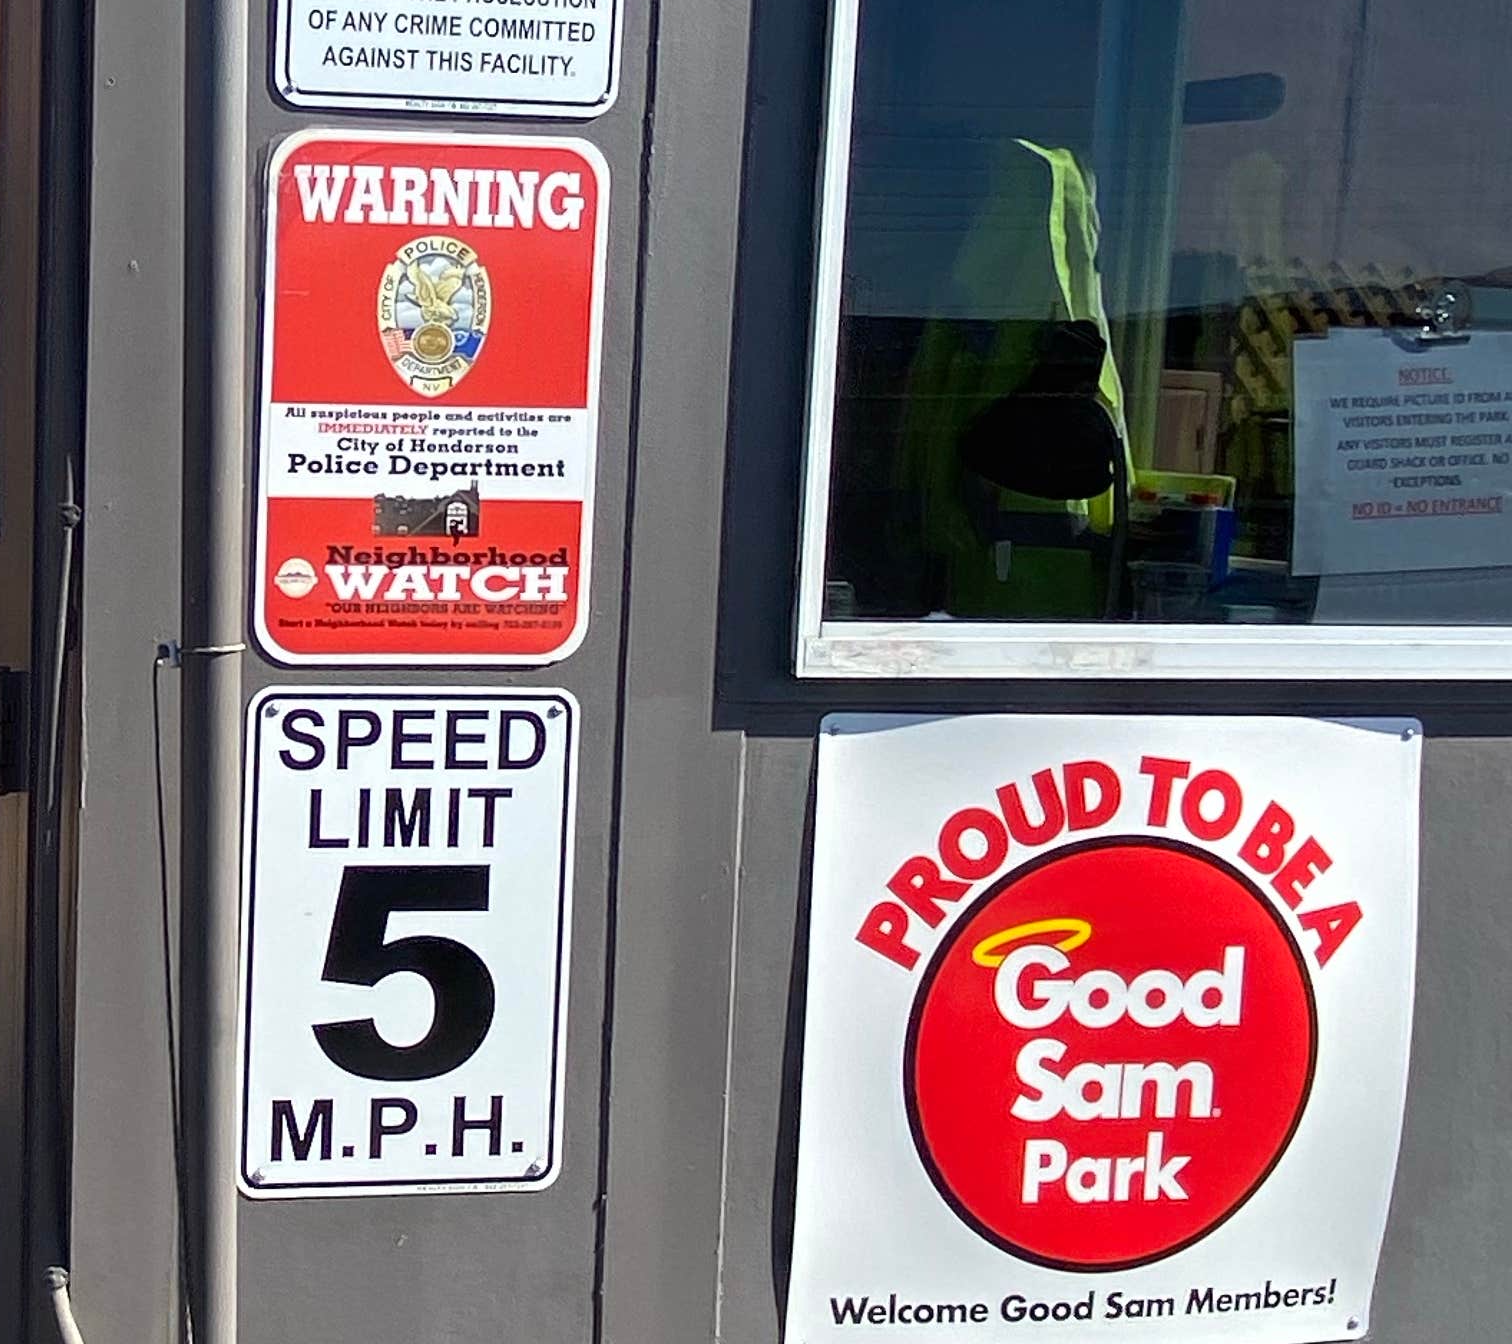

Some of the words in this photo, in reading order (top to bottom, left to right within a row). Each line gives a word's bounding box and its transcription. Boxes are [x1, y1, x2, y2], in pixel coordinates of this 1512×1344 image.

[308, 10, 338, 30] OF
[342, 11, 388, 33] ANY
[394, 13, 462, 36] CRIME
[469, 17, 595, 42] COMMITTED
[322, 46, 419, 70] AGAINST
[426, 50, 473, 72] THIS
[480, 53, 576, 77] FACILITY.
[293, 164, 585, 231] WARNING
[404, 240, 470, 261] POLICE
[382, 294, 392, 320] CITY
[402, 358, 462, 375] DEPARTMENT
[1330, 397, 1348, 408] WE
[1351, 396, 1400, 408] REQUIRE
[1403, 393, 1449, 406] PICTURE
[1453, 393, 1466, 404] ID
[1469, 392, 1501, 403] FROM
[285, 407, 306, 418] All
[311, 409, 387, 421] suspicious
[392, 411, 440, 422] people
[445, 412, 473, 422] and
[477, 412, 543, 422] activities
[1343, 415, 1393, 428] VISITORS
[1396, 413, 1452, 426] ENTERING
[1455, 412, 1476, 424] THE
[318, 423, 427, 435] IMMEDIATELY
[432, 427, 494, 438] reported
[499, 427, 512, 436] to
[517, 427, 538, 437] the
[1337, 440, 1360, 451] ANY
[1363, 438, 1412, 449] VISITORS
[1415, 436, 1447, 448] MUST
[1450, 434, 1502, 446] REGISTER
[337, 437, 379, 453] City
[385, 439, 404, 452] of
[410, 439, 518, 454] Henderson
[288, 453, 378, 474] Police
[388, 455, 565, 481] Department
[1347, 458, 1386, 471] GUARD
[1389, 457, 1426, 468] SHACK
[1429, 456, 1445, 467] OR
[1492, 453, 1509, 464] NO
[1352, 503, 1373, 518] NO
[1377, 502, 1390, 516] ID
[1407, 500, 1428, 515] NO
[1432, 496, 1503, 515] ENTRANCE
[325, 545, 568, 570] Neighborhood
[324, 565, 569, 602] WATCH
[278, 708, 547, 771] SPEED
[308, 787, 513, 849] LIMIT
[855, 759, 1122, 971] PROUD
[1139, 755, 1243, 841] TO
[1237, 799, 1334, 910] BE
[1296, 900, 1364, 968] A
[312, 864, 495, 1082] 5
[994, 945, 1245, 1030] Good
[270, 1095, 524, 1162] M.P.H.
[1021, 1131, 1192, 1204] Park
[830, 1295, 989, 1325] Welcome
[1000, 1291, 1094, 1322] Good
[1104, 1291, 1175, 1319] Sam
[1185, 1278, 1337, 1314] Members!
